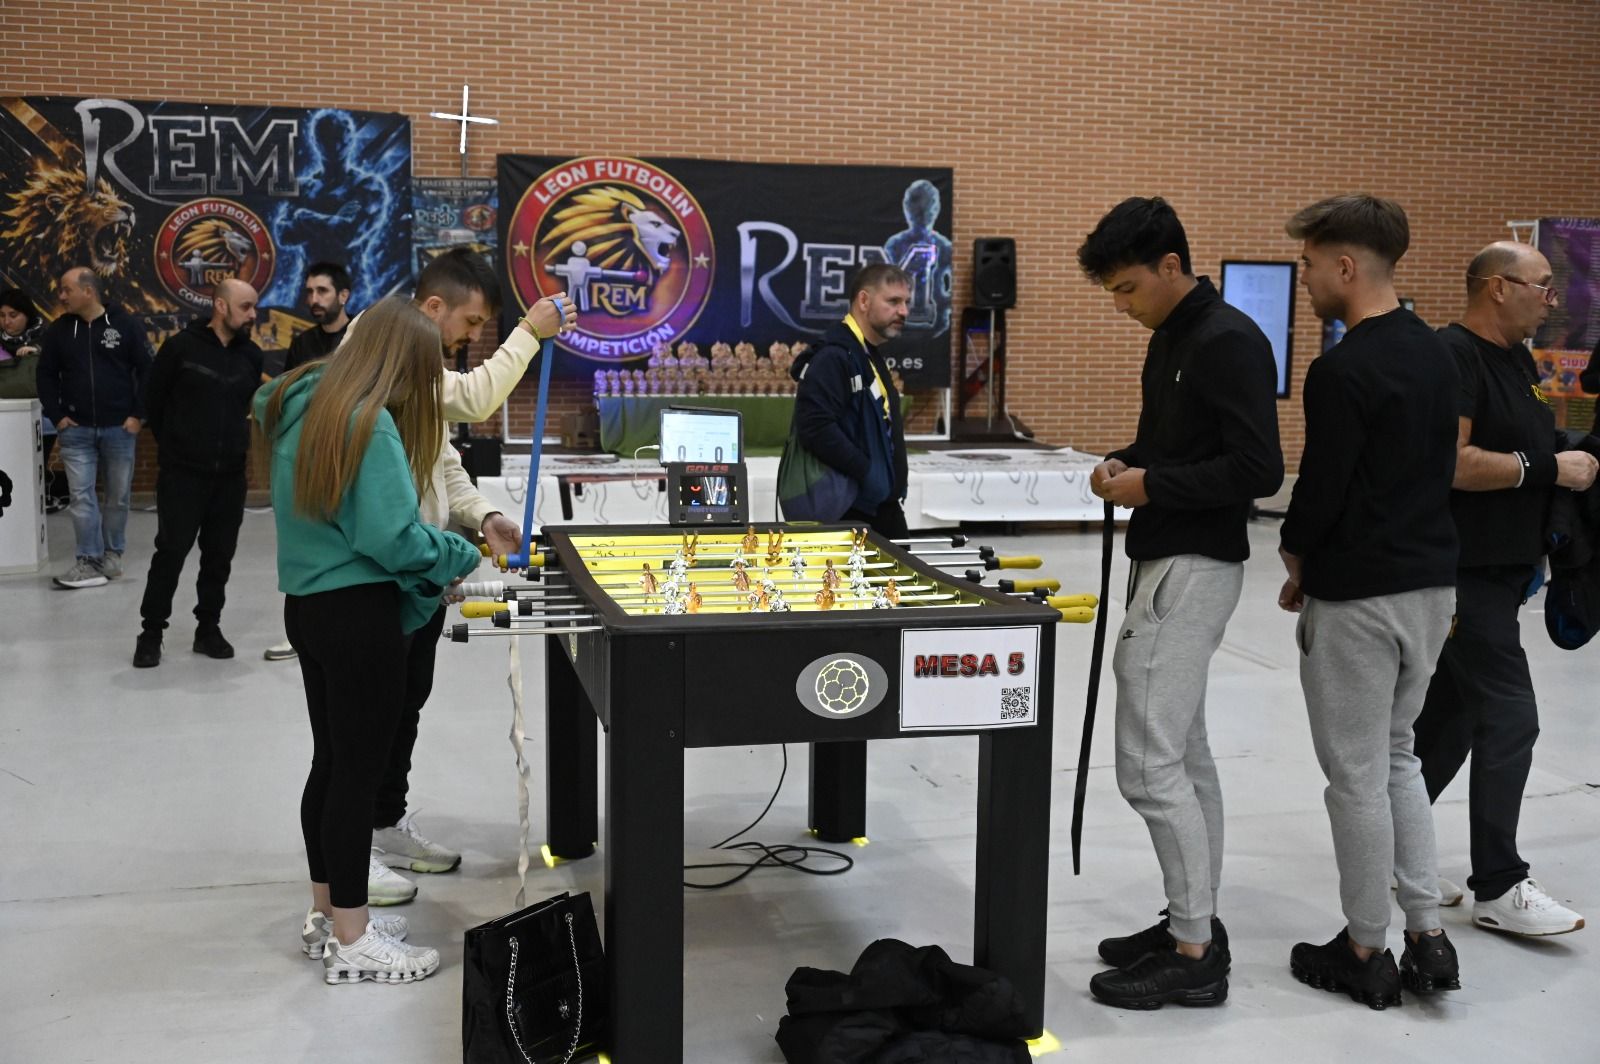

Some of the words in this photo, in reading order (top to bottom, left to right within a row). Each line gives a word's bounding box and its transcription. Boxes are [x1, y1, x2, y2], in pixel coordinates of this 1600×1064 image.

[75, 98, 300, 206] REM
[534, 164, 589, 205] LEON
[594, 161, 694, 218] FUTBOLÍN
[168, 206, 200, 233] LEON
[205, 269, 236, 287] REM
[591, 282, 647, 317] REM
[556, 322, 676, 357] OMPETICIÓN
[885, 356, 924, 370] o.es
[1559, 356, 1588, 369] CIUD
[913, 653, 1000, 679] MESA
[1006, 651, 1026, 677] 5
